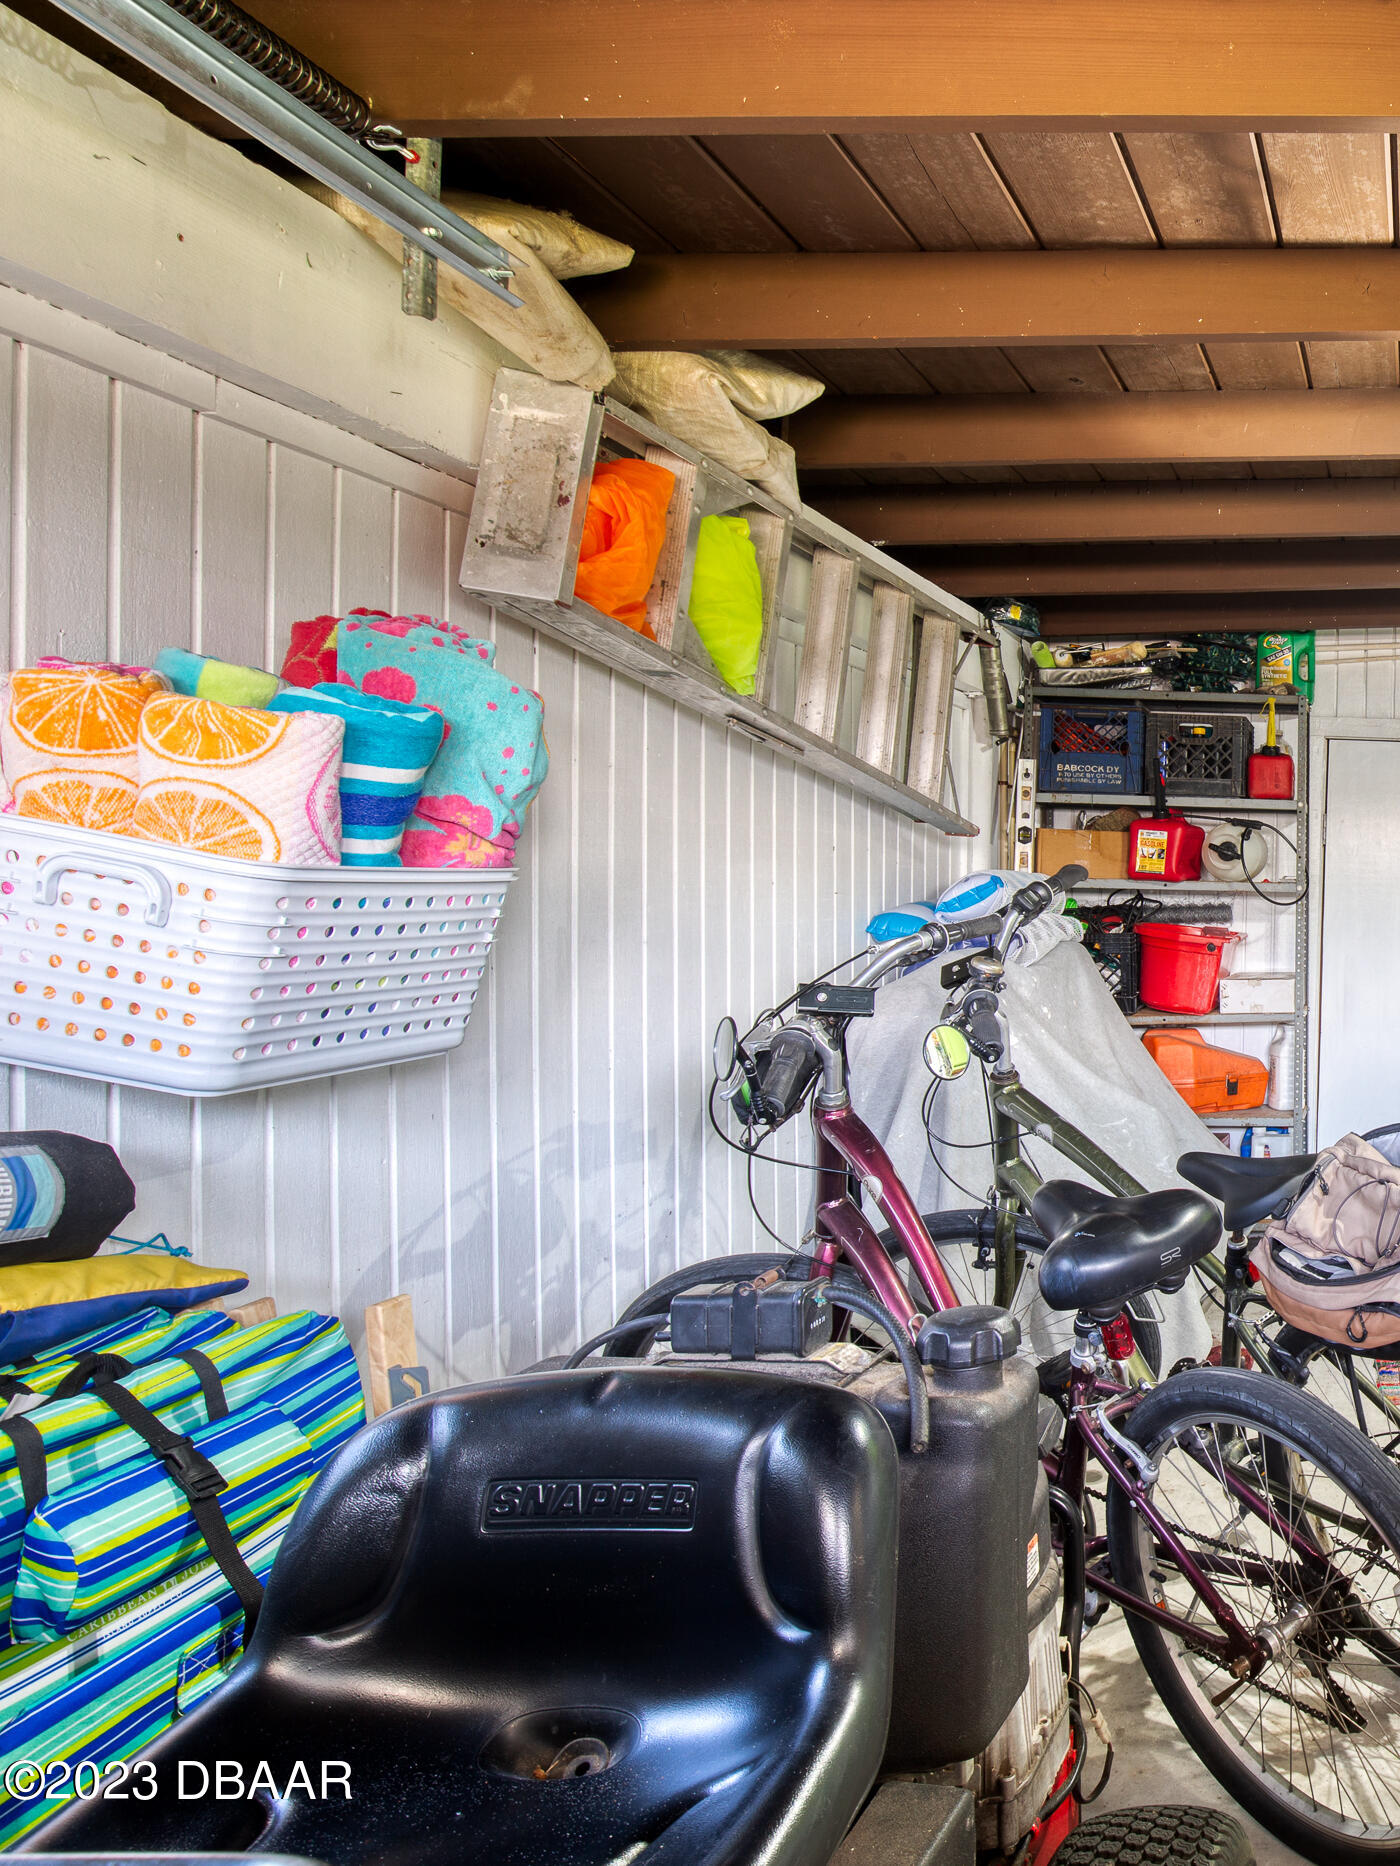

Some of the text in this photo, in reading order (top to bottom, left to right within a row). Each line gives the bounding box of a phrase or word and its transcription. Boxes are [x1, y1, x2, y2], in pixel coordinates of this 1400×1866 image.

[1056, 763, 1120, 774] BABCOCK DY
[488, 1484, 695, 1516] SNAPPER
[66, 1588, 159, 1642] CARIBBEAN
[181, 1560, 210, 1581] JOE
